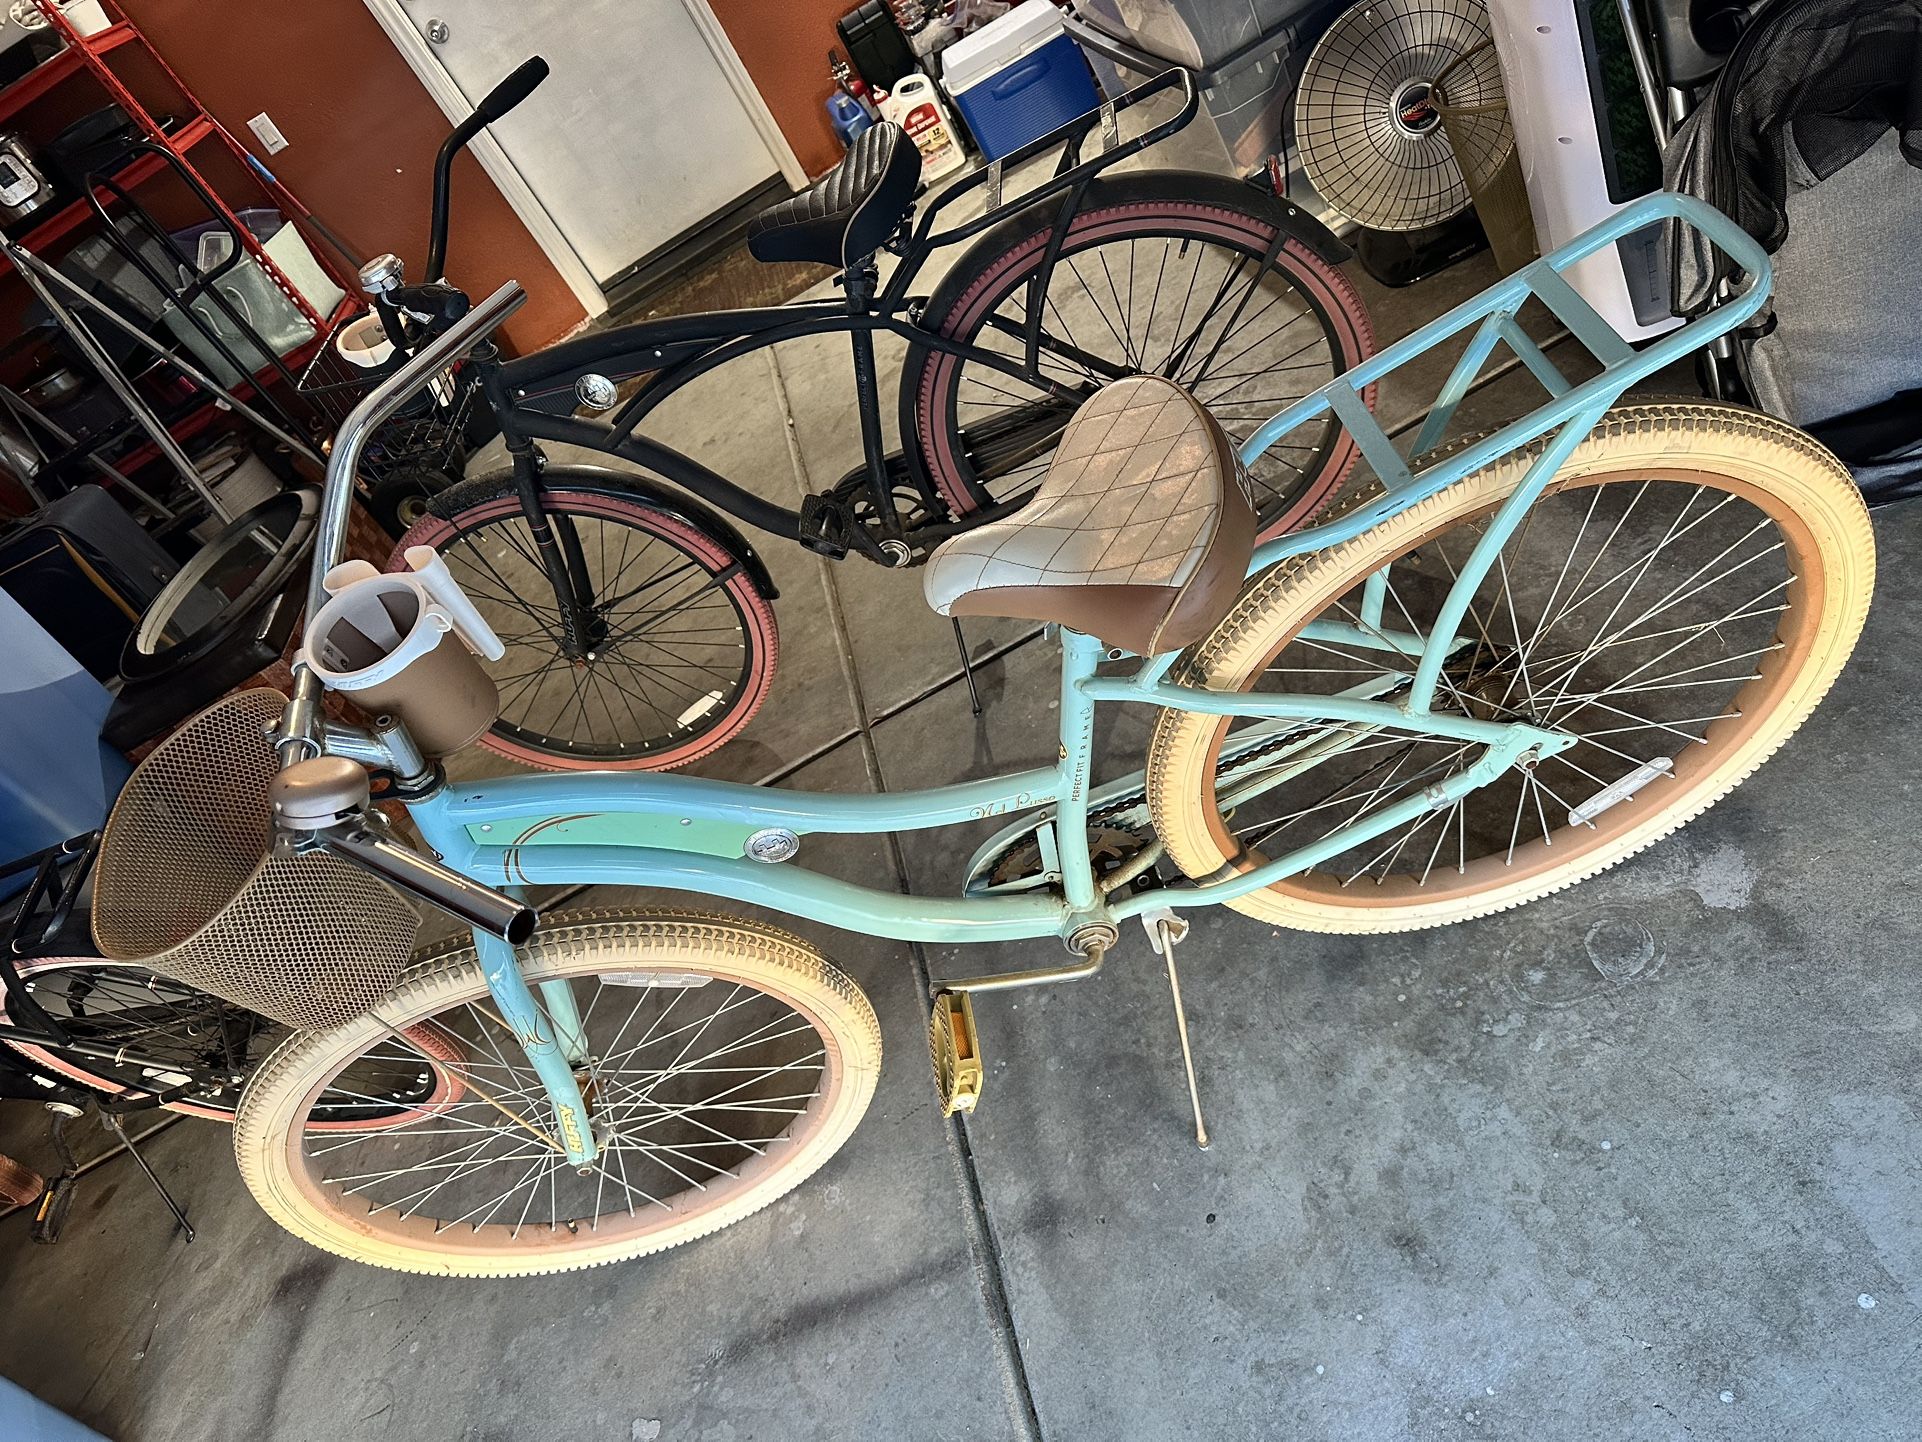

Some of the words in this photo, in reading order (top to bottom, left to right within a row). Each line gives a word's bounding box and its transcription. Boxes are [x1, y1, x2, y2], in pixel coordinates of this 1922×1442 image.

[932, 127, 941, 136] 12
[559, 600, 578, 646] HUFFY
[1079, 715, 1091, 759] FRAME
[1076, 761, 1085, 773] FIT
[1071, 773, 1083, 802] PERFECT
[557, 1103, 585, 1153] HUFFY
